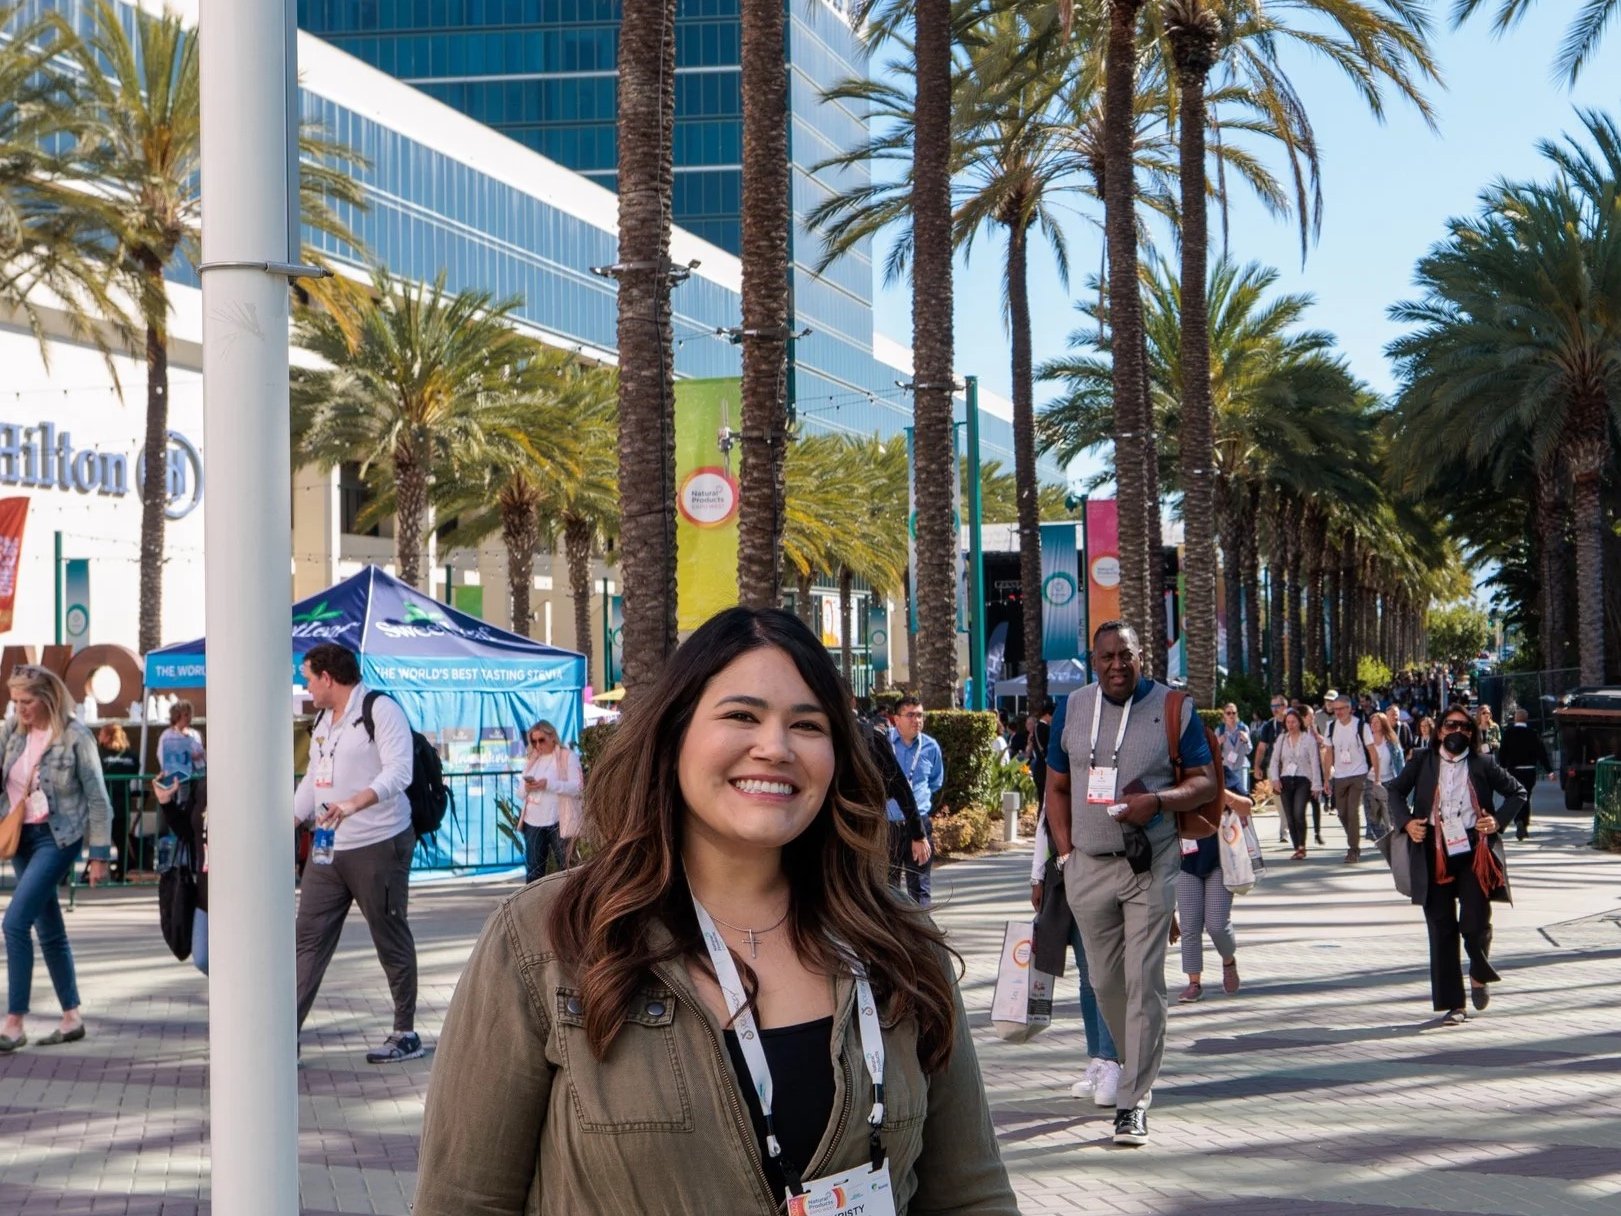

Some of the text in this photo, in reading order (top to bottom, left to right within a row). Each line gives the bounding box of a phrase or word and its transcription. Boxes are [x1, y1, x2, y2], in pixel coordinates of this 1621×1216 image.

[0, 421, 129, 497] Hilton
[155, 665, 206, 677] THE WORL
[374, 666, 563, 681] THE WORLD'S BEST TASTING STEVIA
[808, 1195, 828, 1205] Natural
[808, 1200, 834, 1210] Products
